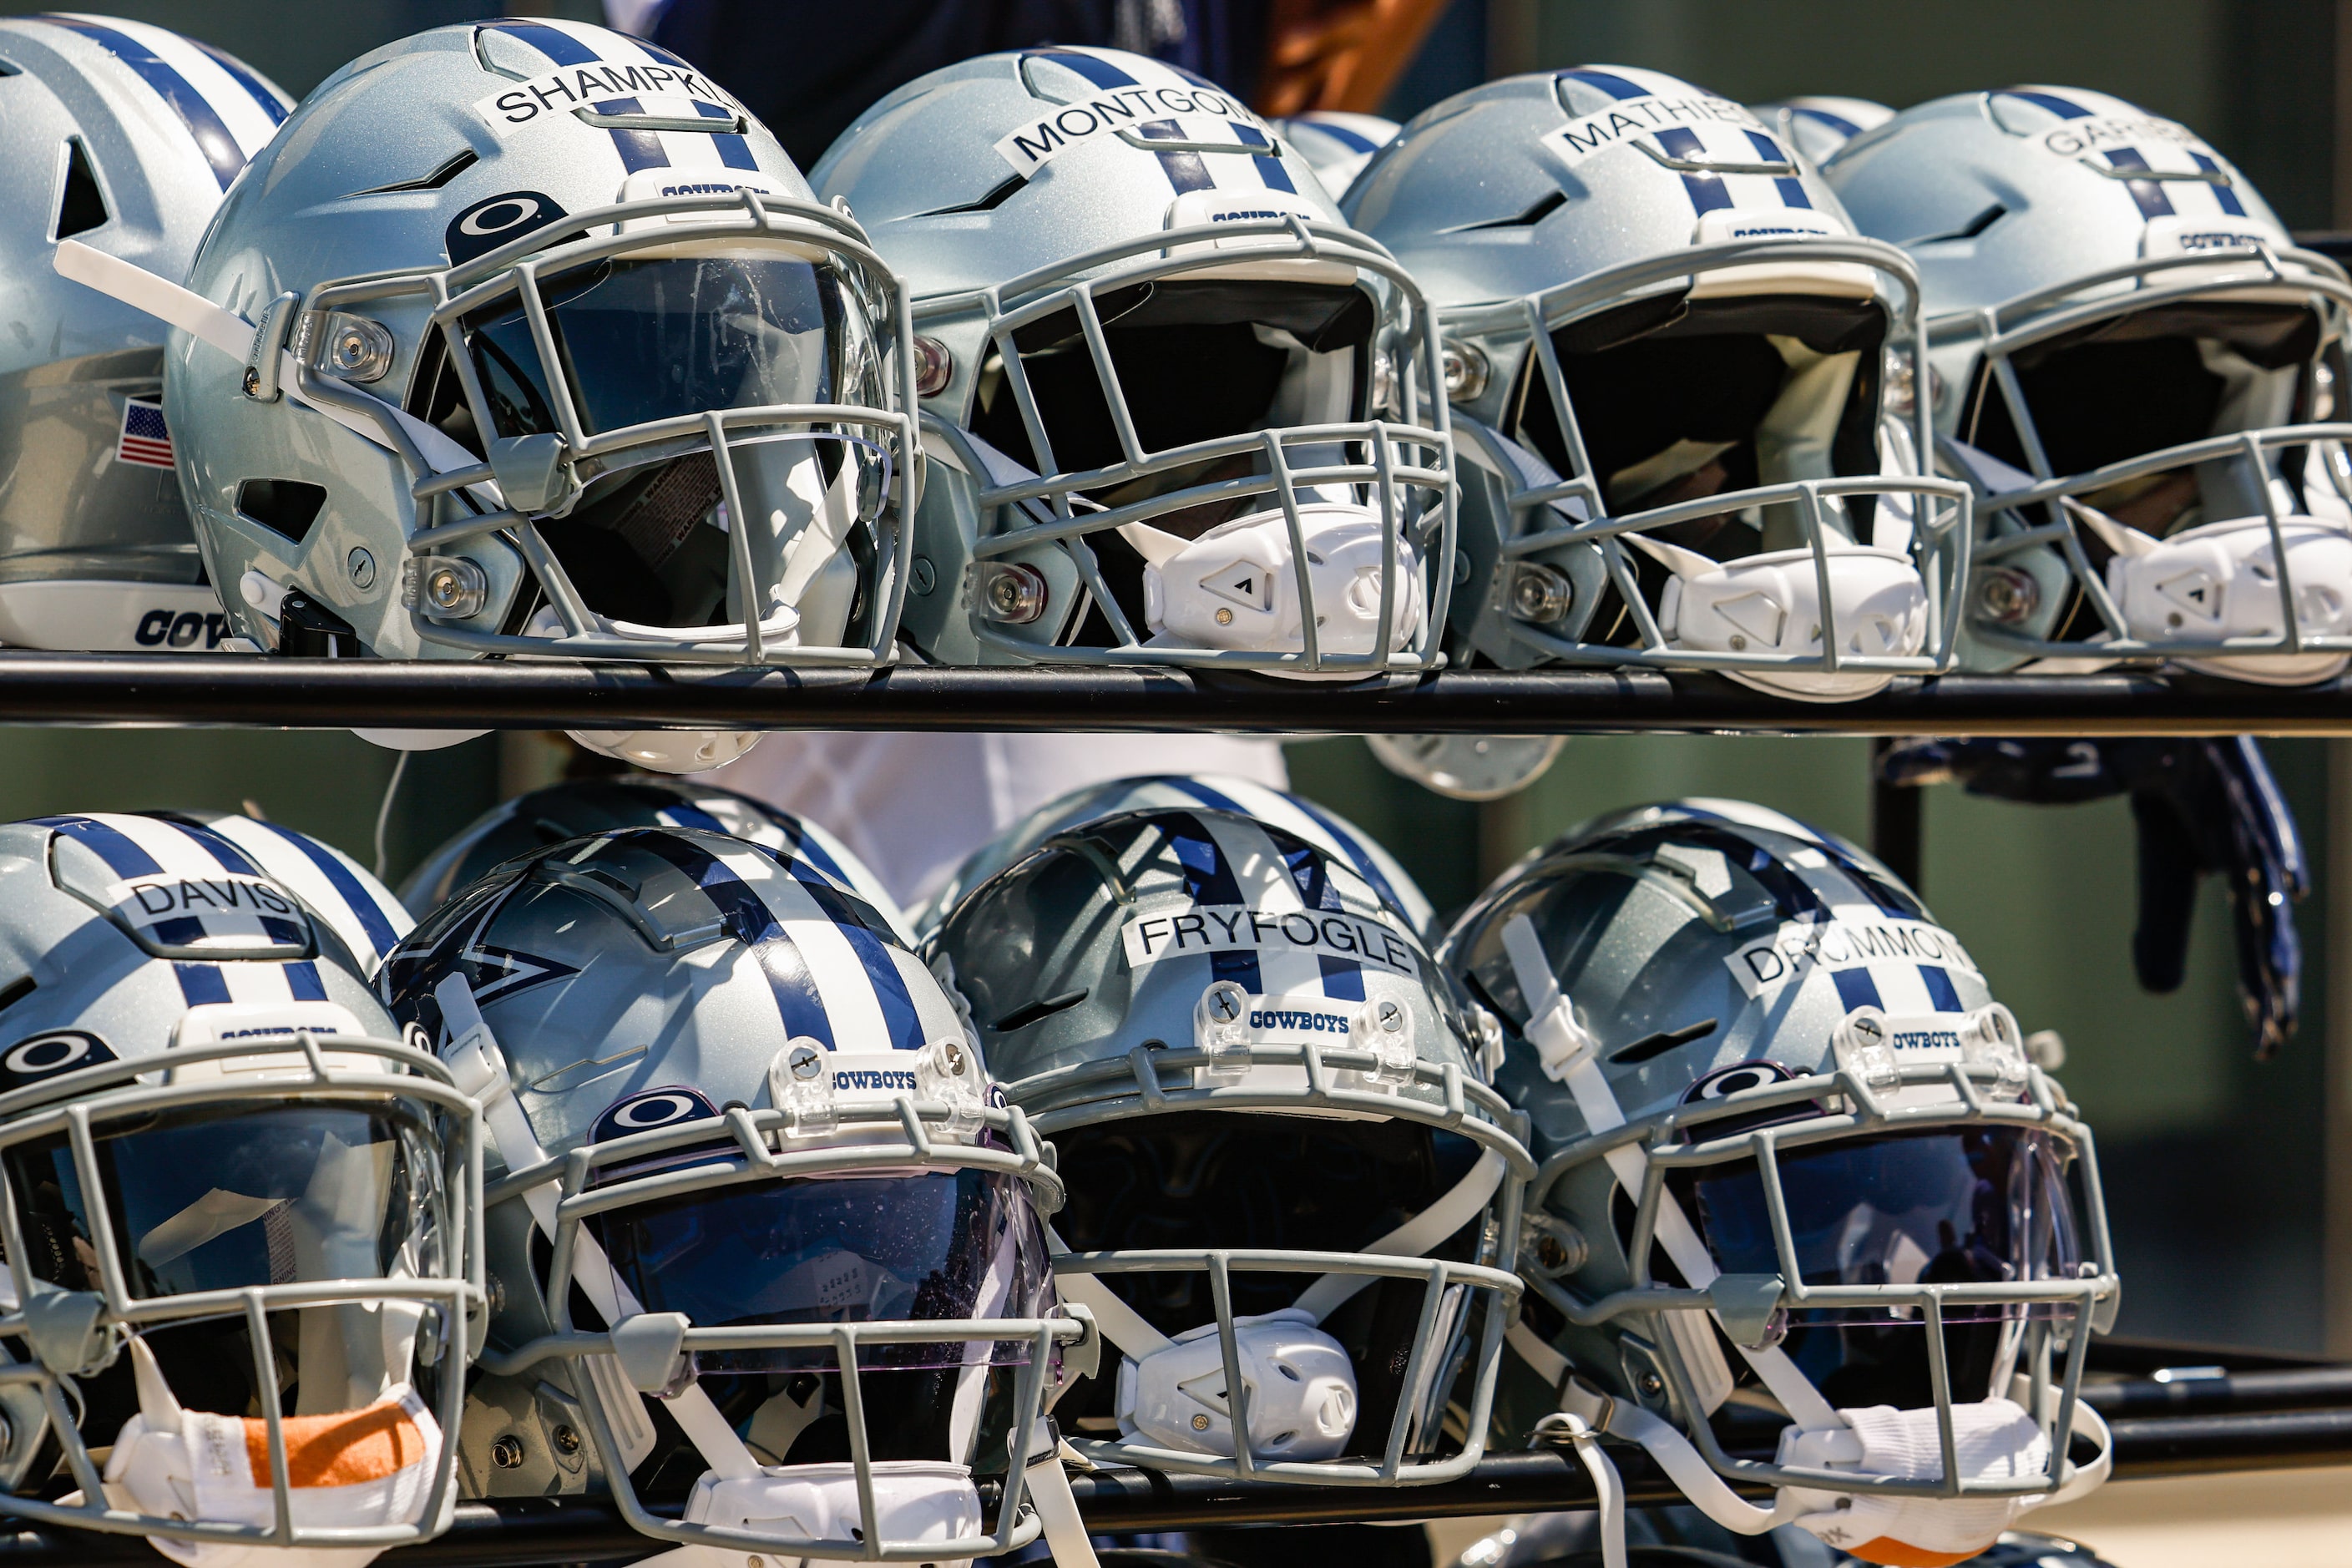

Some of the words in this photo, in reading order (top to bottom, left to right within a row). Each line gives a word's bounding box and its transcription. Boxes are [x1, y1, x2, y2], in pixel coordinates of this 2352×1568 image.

[676, 498, 713, 541] WARNING
[131, 878, 291, 916] DAVIS
[1138, 910, 1413, 974] FRYFOGLE
[1249, 1010, 1349, 1034] COWBOYS
[1893, 1031, 1960, 1050] OWBOYS
[832, 1070, 918, 1090] OWBOYS
